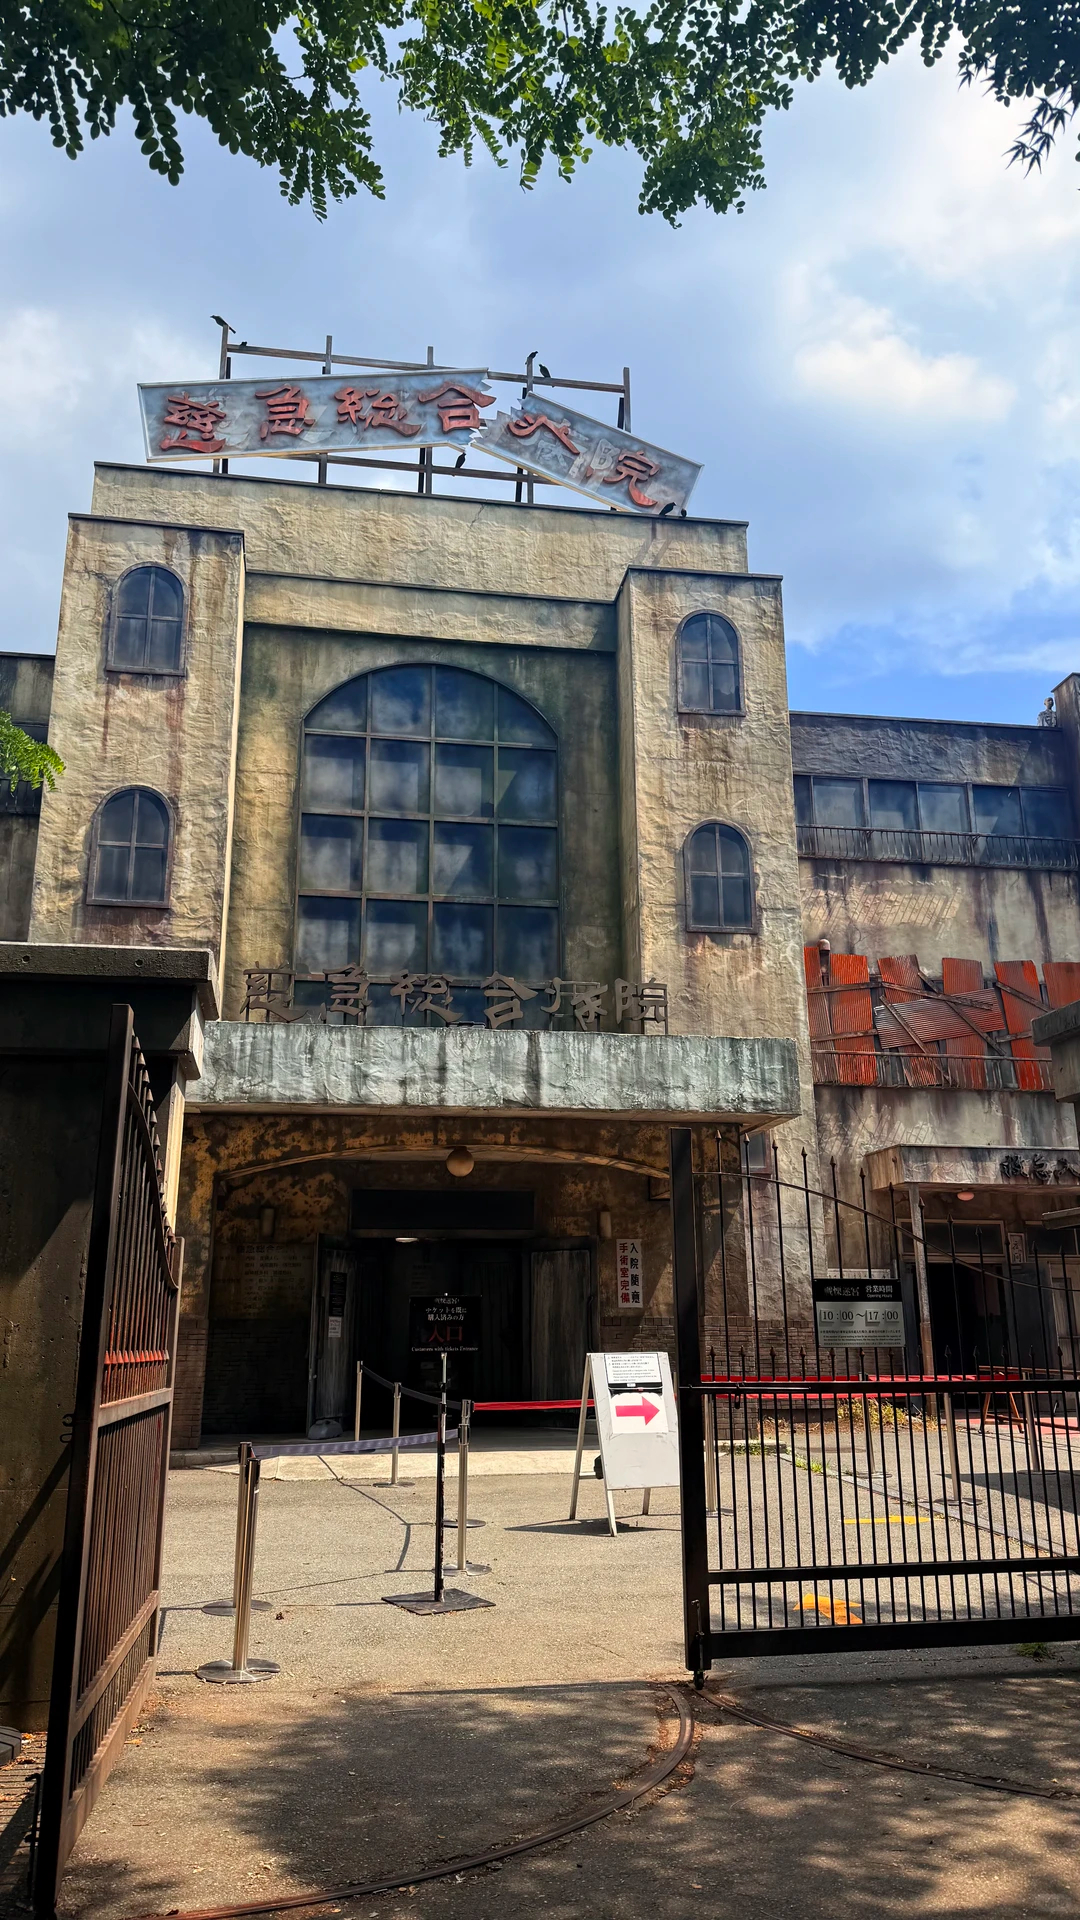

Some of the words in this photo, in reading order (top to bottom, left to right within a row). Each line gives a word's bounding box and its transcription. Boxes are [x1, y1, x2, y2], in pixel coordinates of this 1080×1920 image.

[619, 1242, 630, 1303] 手術室完備
[865, 1285, 893, 1293] 営業時間
[428, 1324, 463, 1343] 入口
